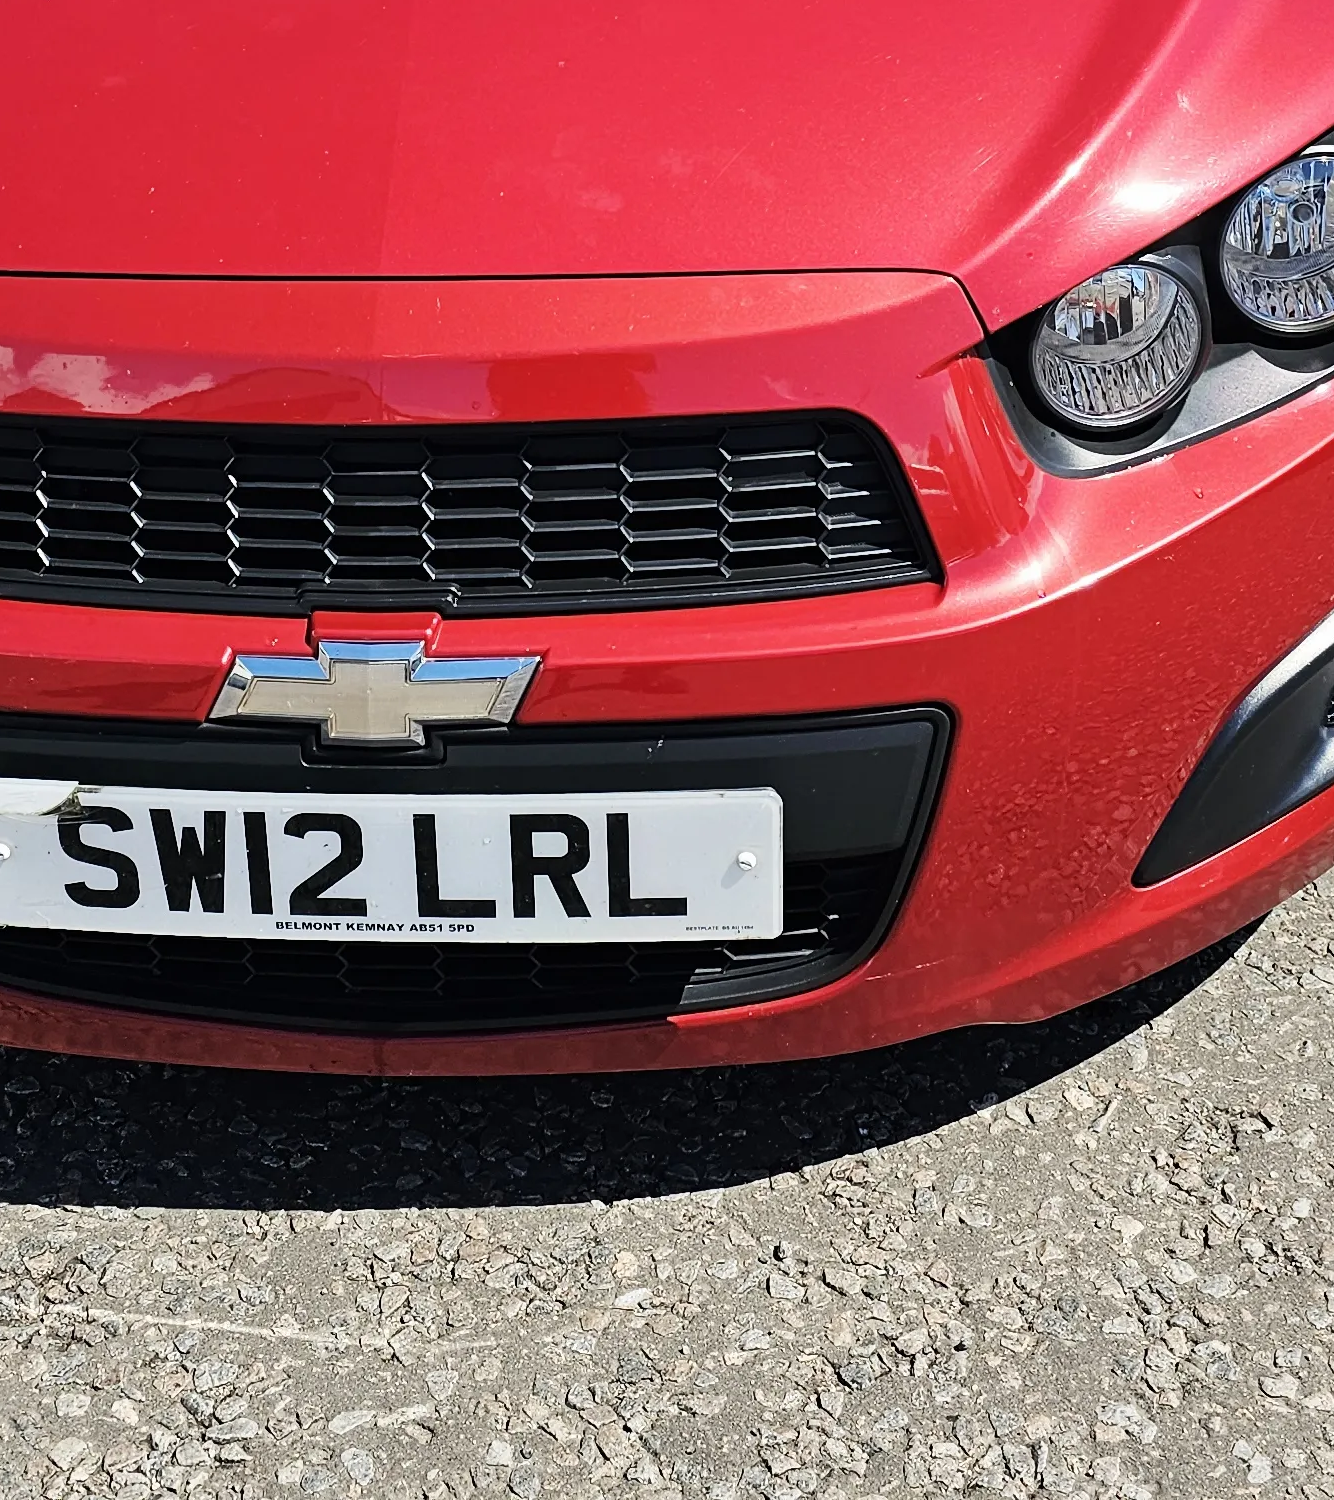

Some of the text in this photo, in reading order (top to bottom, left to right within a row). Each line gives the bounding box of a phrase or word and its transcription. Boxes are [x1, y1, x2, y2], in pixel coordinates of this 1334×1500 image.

[57, 805, 688, 919] SW12 LRL
[275, 921, 475, 933] BELMONT KEMNAY AB51 5PD
